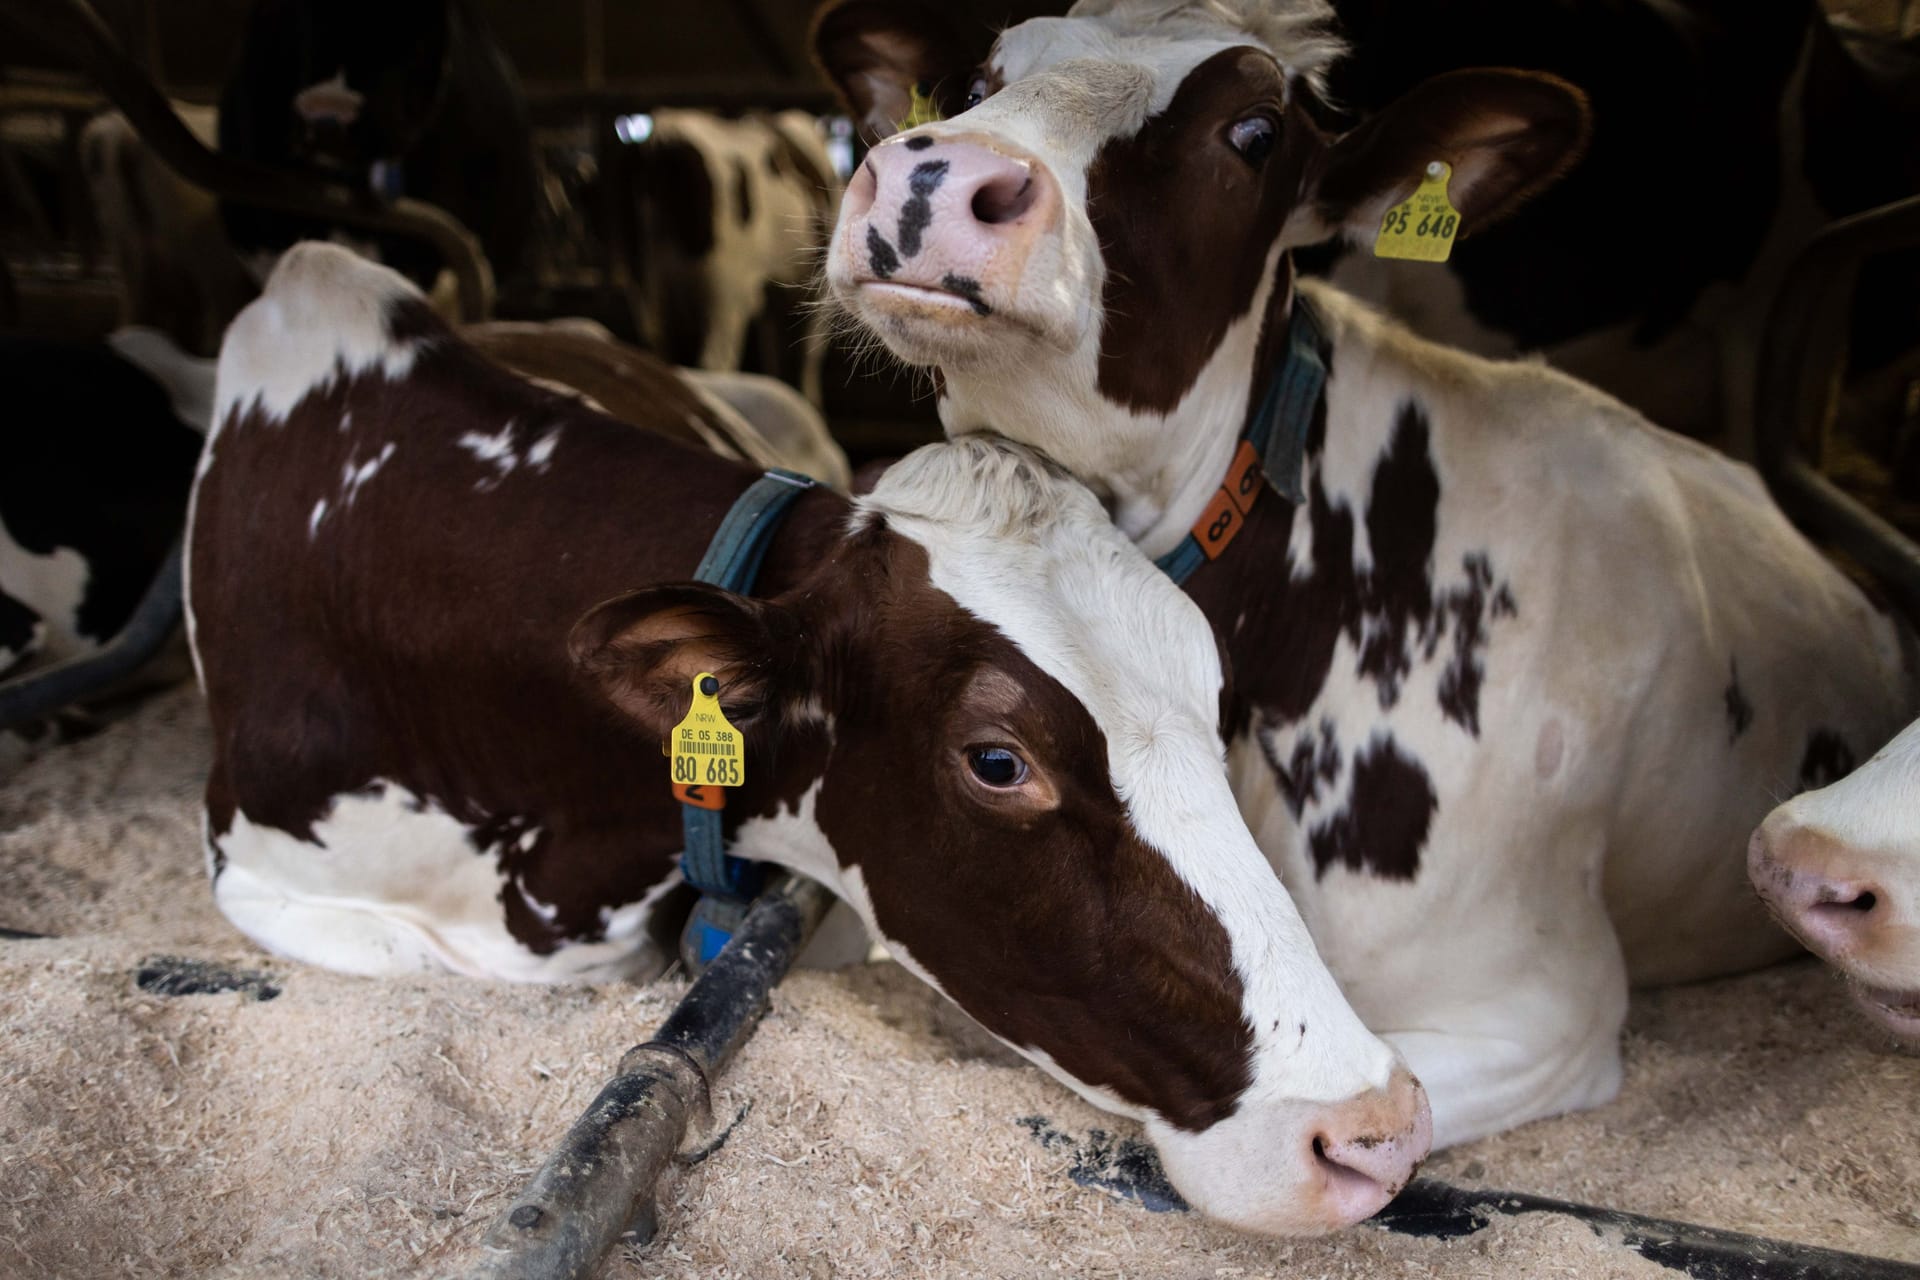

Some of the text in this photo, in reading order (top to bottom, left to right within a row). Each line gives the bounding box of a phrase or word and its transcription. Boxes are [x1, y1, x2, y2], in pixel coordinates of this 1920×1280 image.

[1383, 211, 1456, 238] 95 648
[695, 713, 716, 723] NRW
[682, 729, 733, 742] DE 05 388
[675, 756, 738, 784] 80 685
